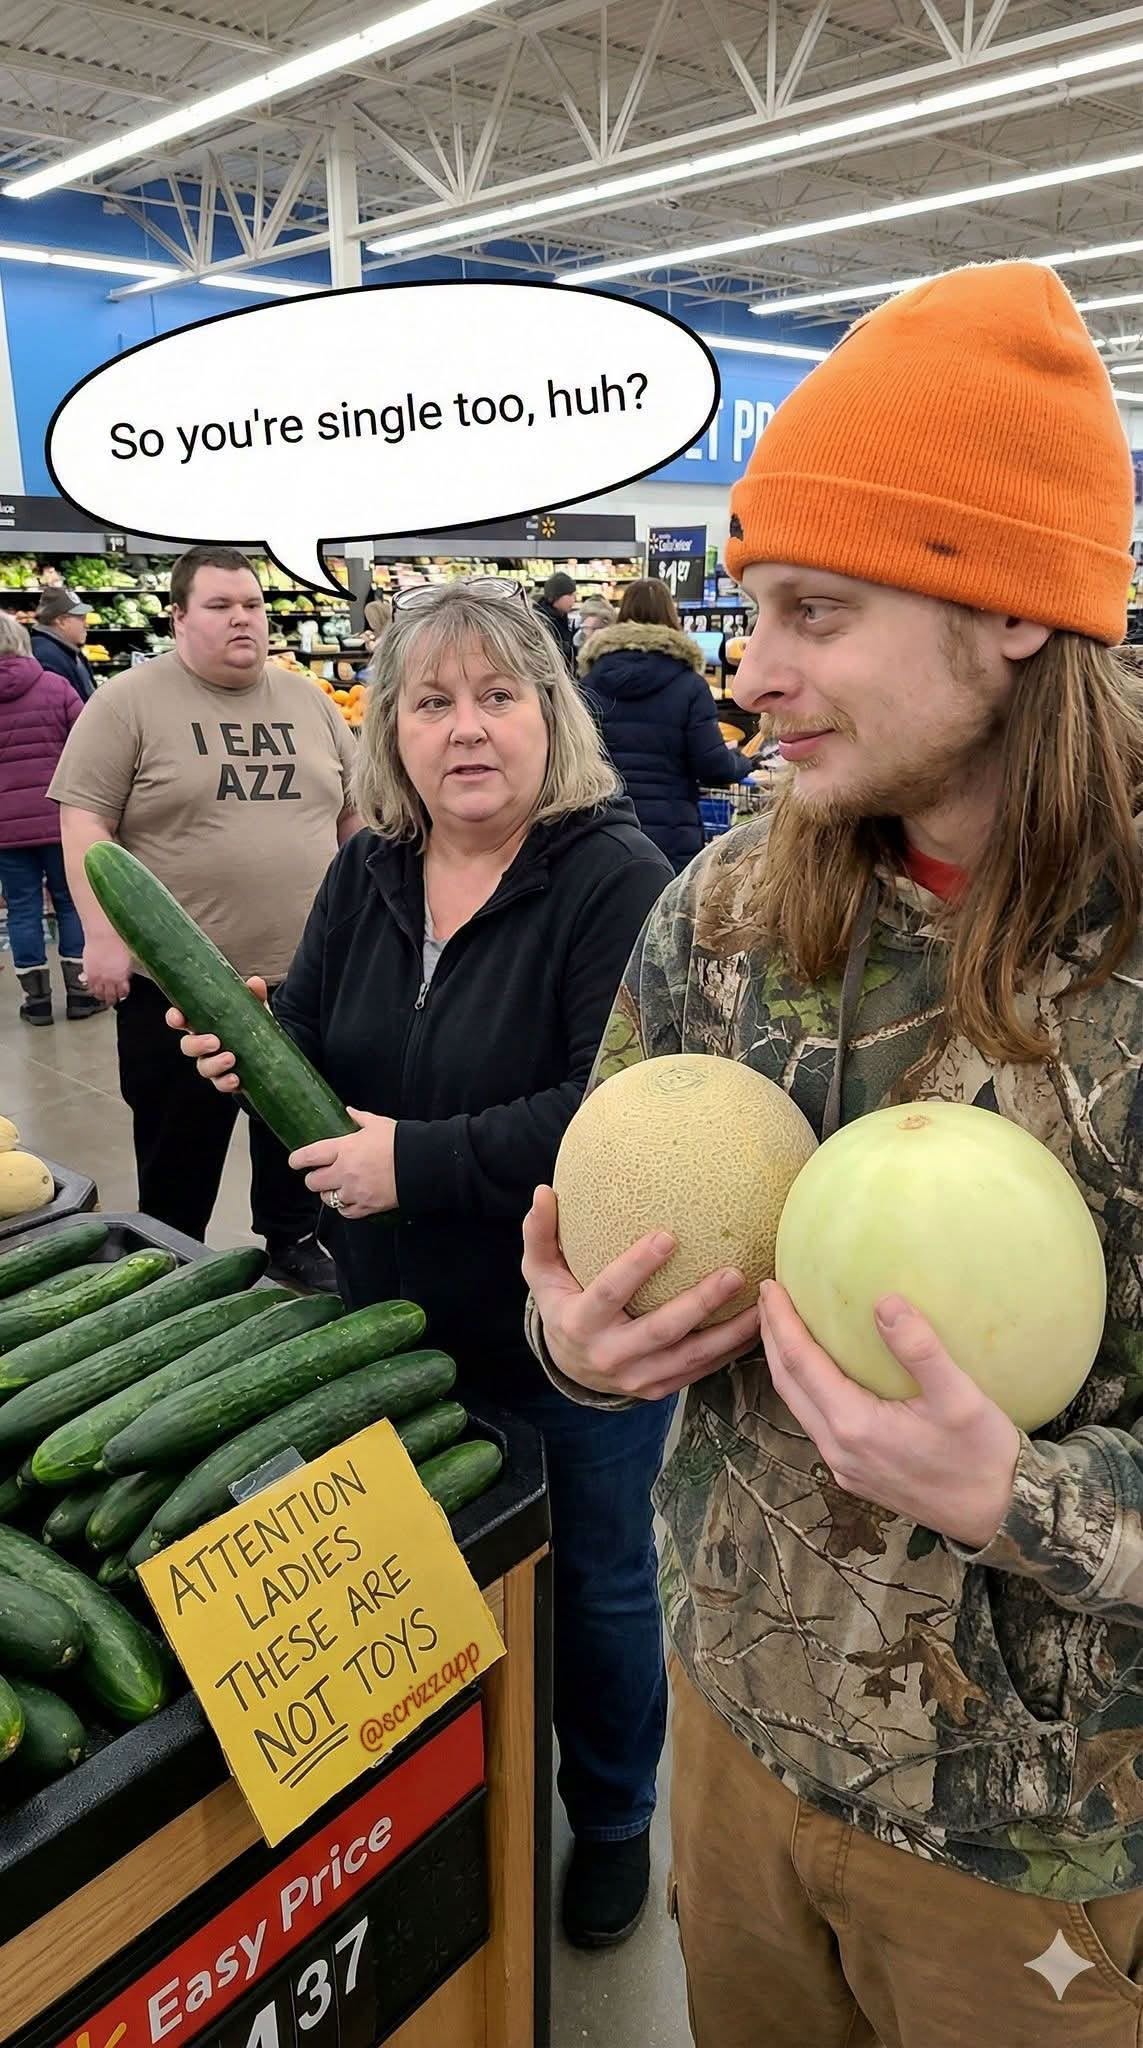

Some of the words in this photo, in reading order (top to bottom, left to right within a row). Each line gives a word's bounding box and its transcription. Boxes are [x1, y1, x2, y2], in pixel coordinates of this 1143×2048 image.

[191, 722, 208, 756] I
[219, 722, 297, 757] EAT
[216, 763, 302, 801] AZZ
[169, 1460, 368, 1616] ATTENTION
[235, 1525, 362, 1631] LADIES
[214, 1607, 339, 1712] THESE
[346, 1553, 412, 1627] ARE
[253, 1674, 336, 1775] NOT
[342, 1607, 438, 1695] TOYS
[148, 1918, 267, 2045] Easy
[280, 1815, 393, 1933] Price
